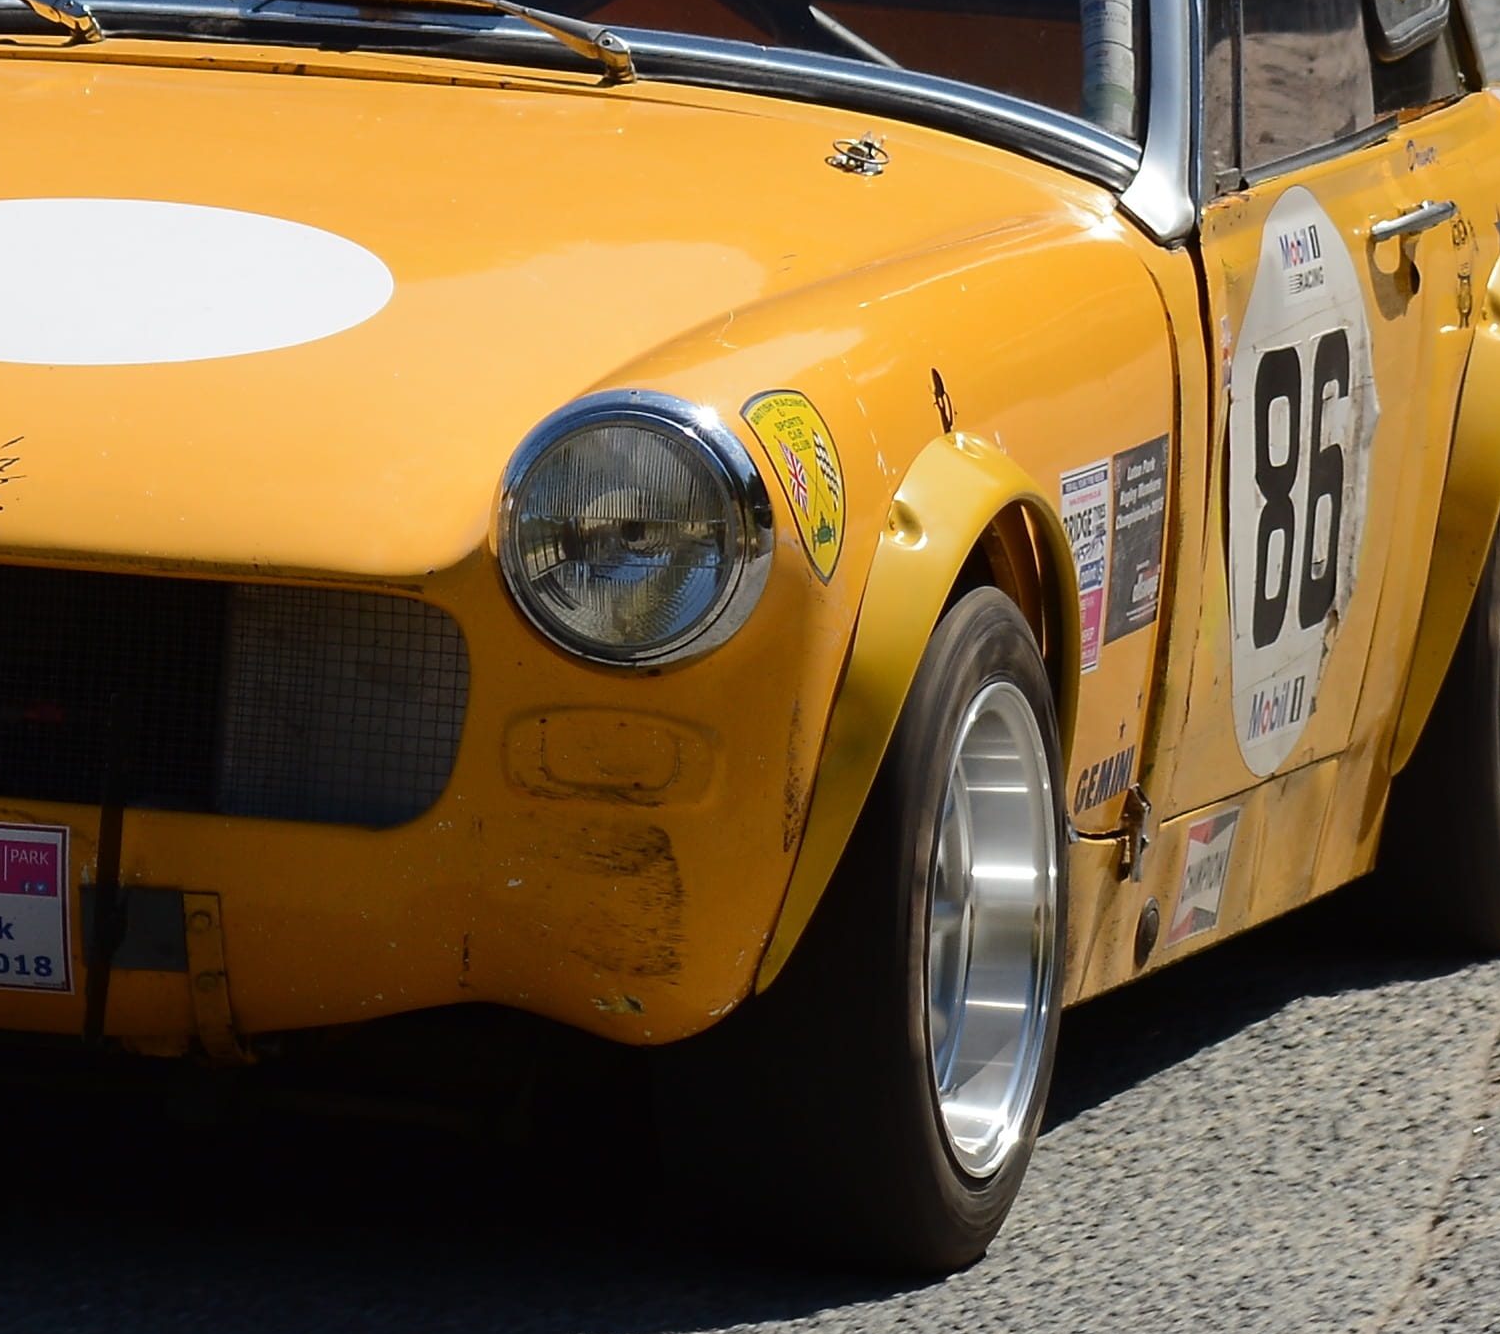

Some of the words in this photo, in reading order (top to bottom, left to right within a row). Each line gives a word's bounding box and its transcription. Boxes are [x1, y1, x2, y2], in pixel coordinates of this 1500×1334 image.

[1279, 227, 1310, 270] Mobil
[750, 402, 775, 425] BRITISH
[773, 398, 807, 408] RACING
[774, 415, 804, 432] SPORTS
[787, 428, 803, 441] CAR
[791, 439, 812, 453] CLUB
[1252, 327, 1350, 649] 86
[1247, 679, 1289, 743] Mobil
[1074, 745, 1135, 816] GEMINI
[10, 849, 49, 865] PARK
